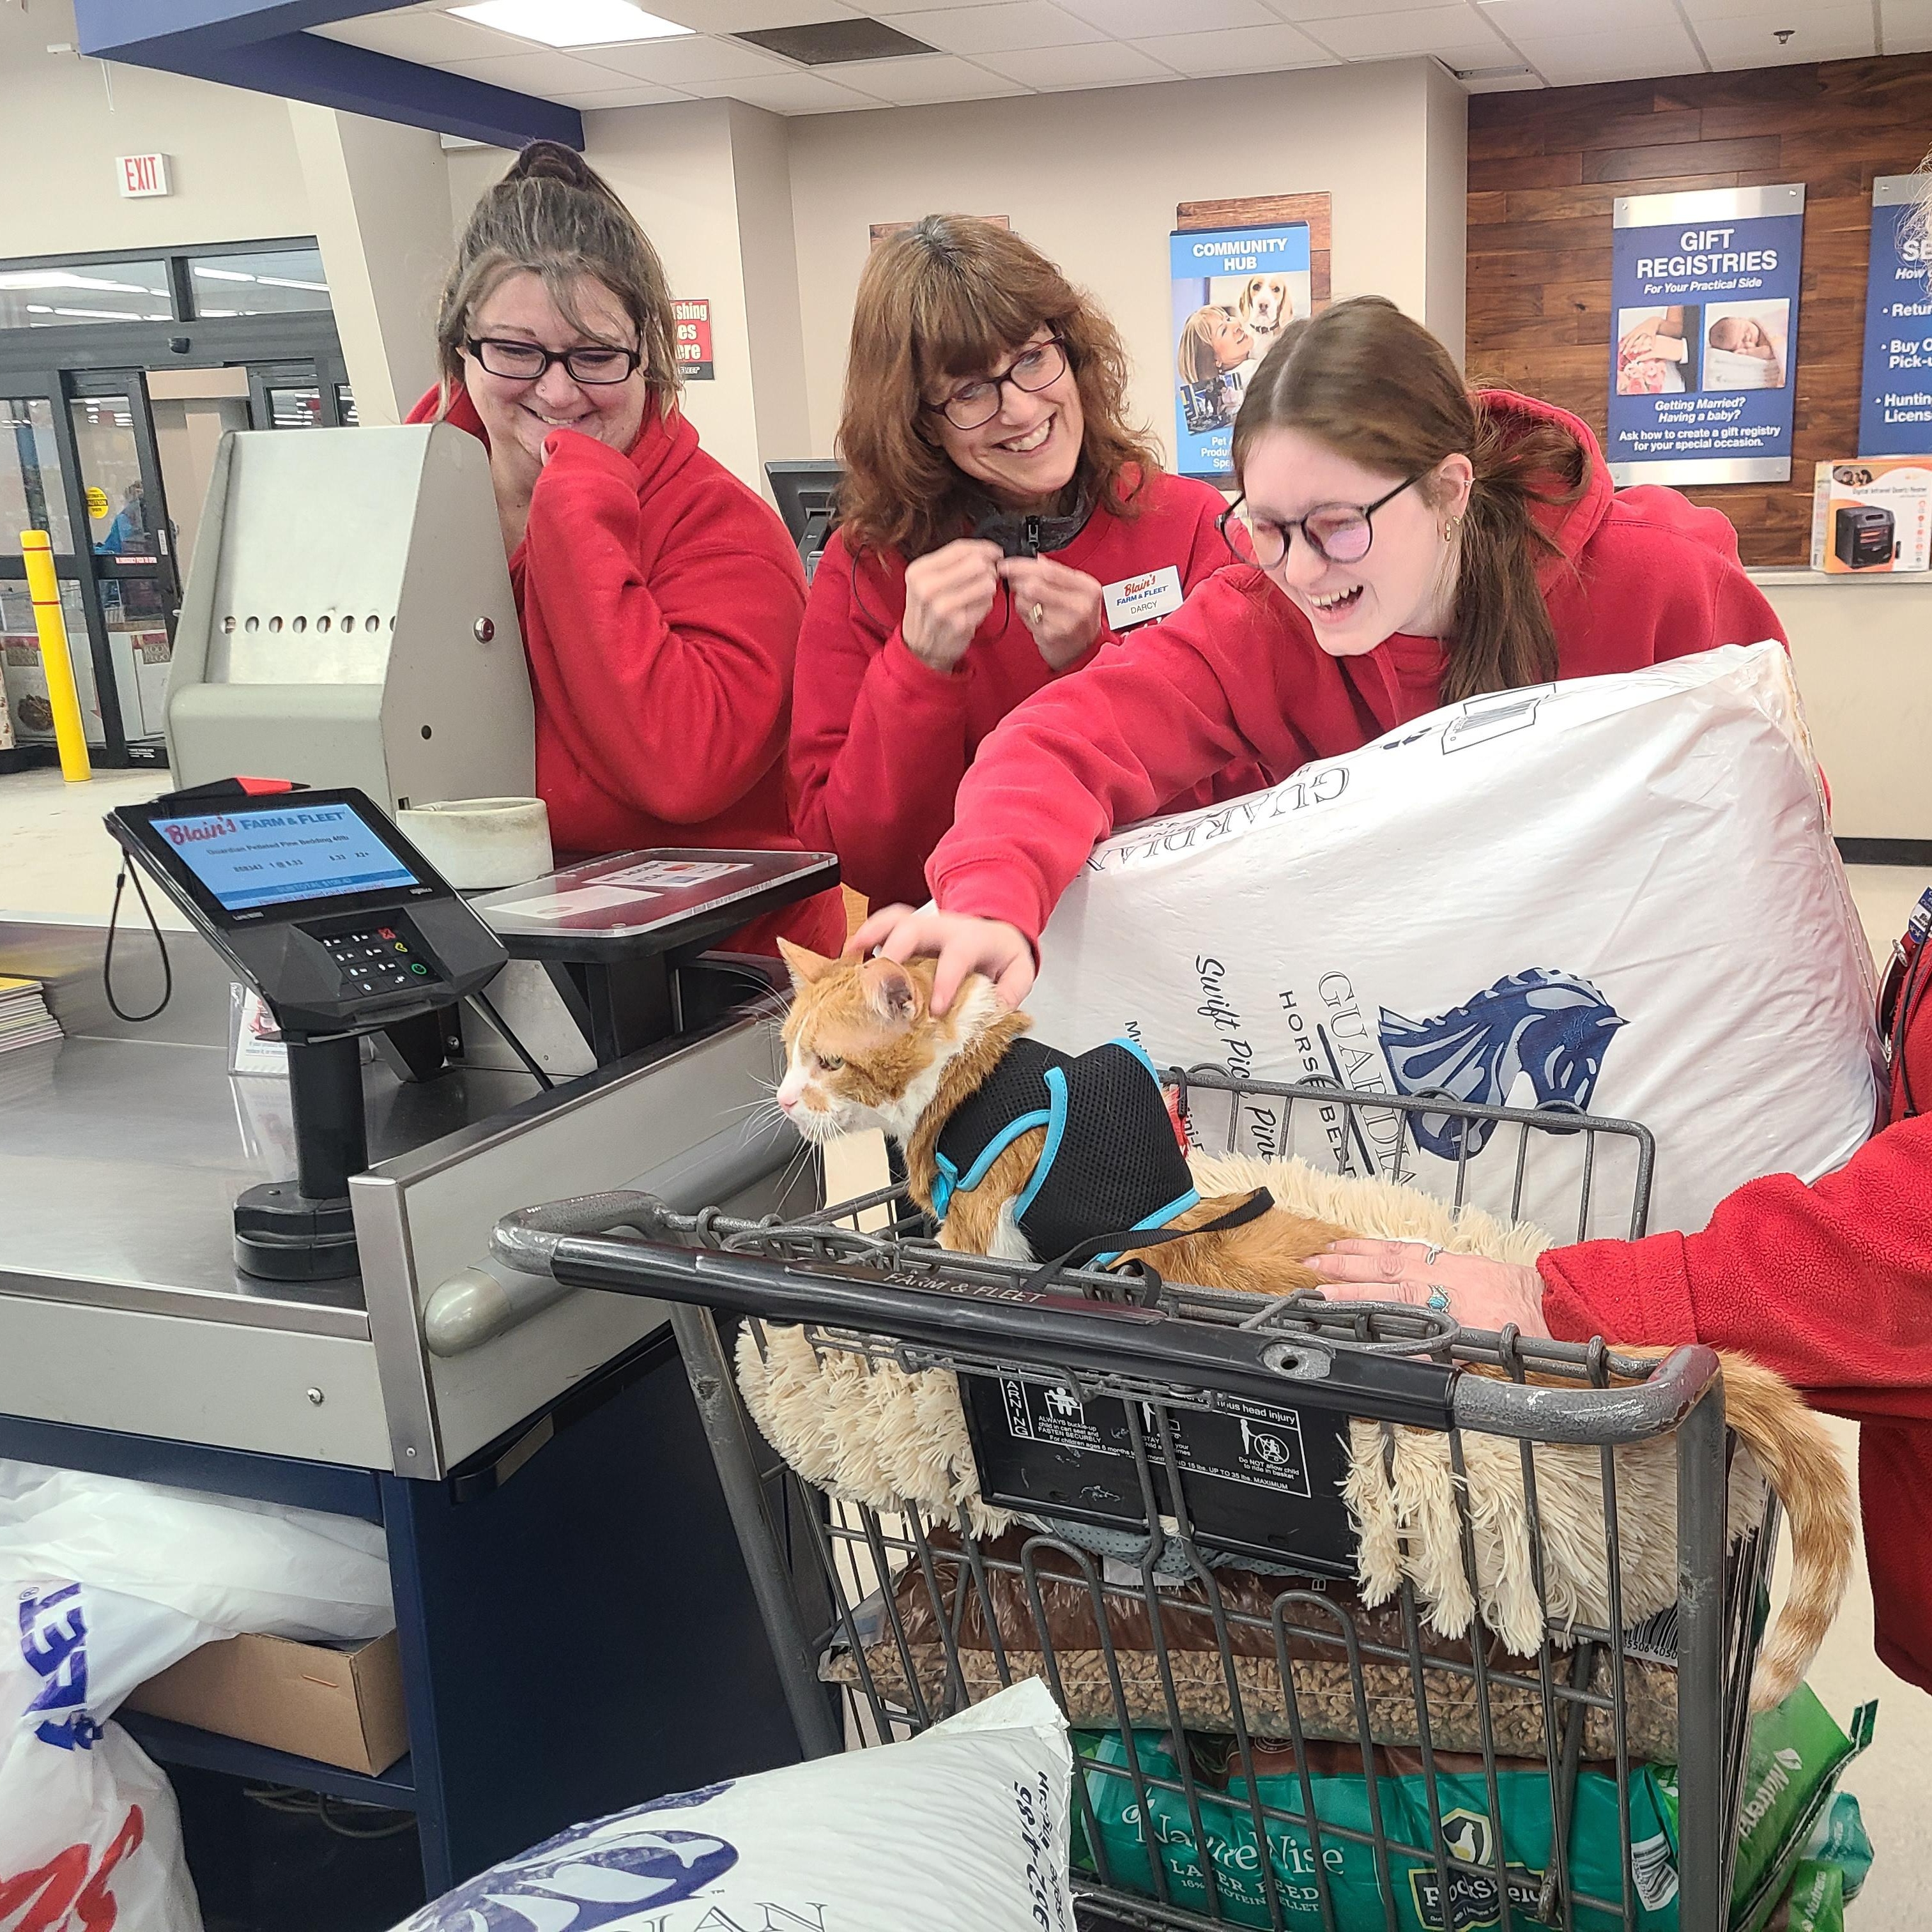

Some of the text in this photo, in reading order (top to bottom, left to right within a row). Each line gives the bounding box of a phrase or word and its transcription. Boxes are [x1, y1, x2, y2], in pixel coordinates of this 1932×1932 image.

[125, 157, 157, 191] EXIT
[1192, 238, 1288, 257] COMMUNITY
[1680, 229, 1735, 251] GIFT
[1223, 258, 1257, 272] HUB
[1637, 250, 1777, 279] REGISTRIES
[1895, 267, 1927, 280] How
[1644, 277, 1763, 295] For Your Practical Side
[671, 302, 707, 321] shing
[1890, 339, 1920, 355] Buy
[1655, 397, 1746, 411] Getting Married?
[1884, 392, 1932, 407] Huntin
[1658, 412, 1696, 424] Having
[1706, 410, 1742, 422] baby?
[1211, 437, 1227, 446] Pet
[1619, 431, 1639, 441] Ask
[1641, 430, 1663, 440] how
[1664, 430, 1675, 439] to
[1677, 429, 1710, 438] create
[1721, 426, 1739, 439] gift
[1740, 425, 1781, 438] registry
[1634, 438, 1765, 452] for your special occasion.
[1124, 574, 1156, 597] Blain's
[1117, 595, 1137, 606] FARM
[1144, 585, 1169, 598] FLEET
[1130, 601, 1157, 614] DARCY
[165, 811, 346, 845] Blain's FARM & FLEET
[1195, 954, 1241, 1032] Swift
[1318, 970, 1417, 1186] GUARDIA
[884, 1271, 1046, 1305] FARM & FLEET
[1007, 1381, 1029, 1436] ARNING
[1243, 1404, 1266, 1417] head
[1039, 1416, 1097, 1432] ALWAYS buckle-up
[1038, 1427, 1101, 1443] FASTEN SECURELY
[1061, 1438, 1084, 1446] children
[1107, 1446, 1130, 1456] months
[1272, 1470, 1294, 1480] basket
[1284, 1468, 1300, 1476] child
[1254, 1476, 1288, 1489] MAXIMUM
[1653, 1647, 1678, 1660] 4050
[1122, 1803, 1344, 1874] NaureWise
[1170, 1859, 1246, 1893] LAER
[1181, 1880, 1319, 1912] 16% ROTEIN ELLET
